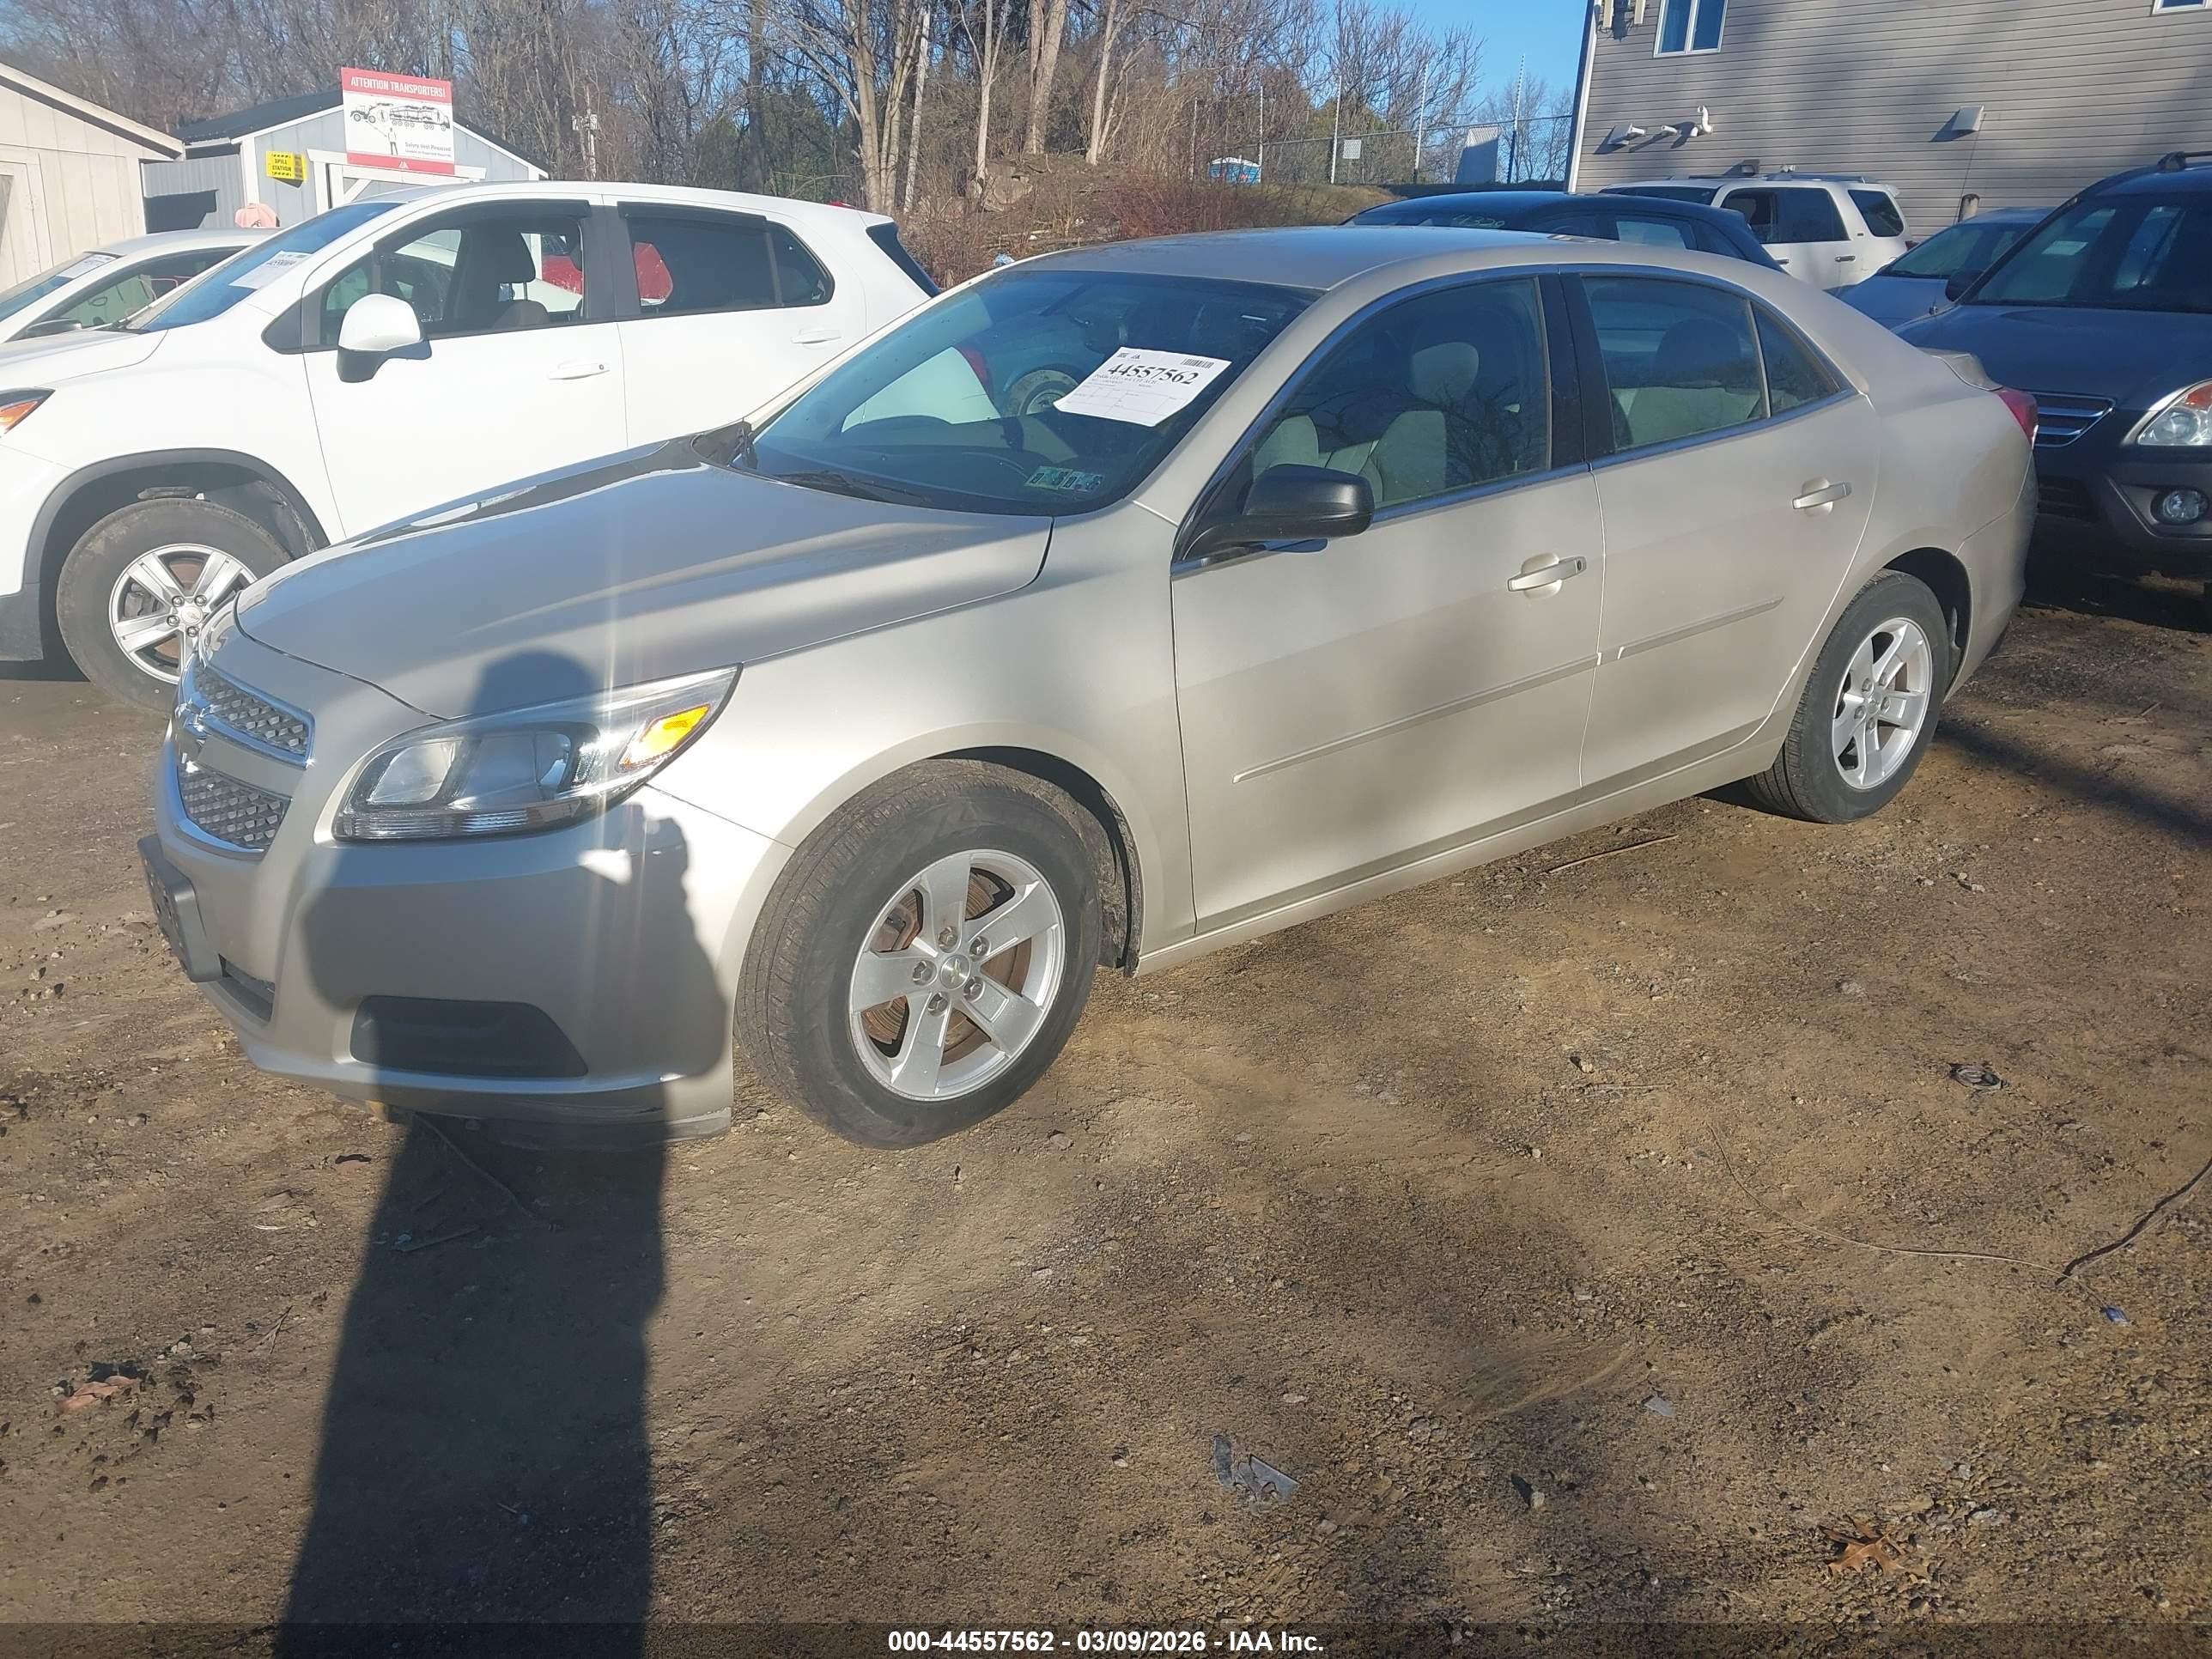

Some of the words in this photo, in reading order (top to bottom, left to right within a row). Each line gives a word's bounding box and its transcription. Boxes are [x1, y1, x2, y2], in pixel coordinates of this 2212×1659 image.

[350, 76, 389, 91] ATTENTION
[389, 81, 446, 98] TRANSPORTERS!
[1108, 362, 1200, 385] 44557562
